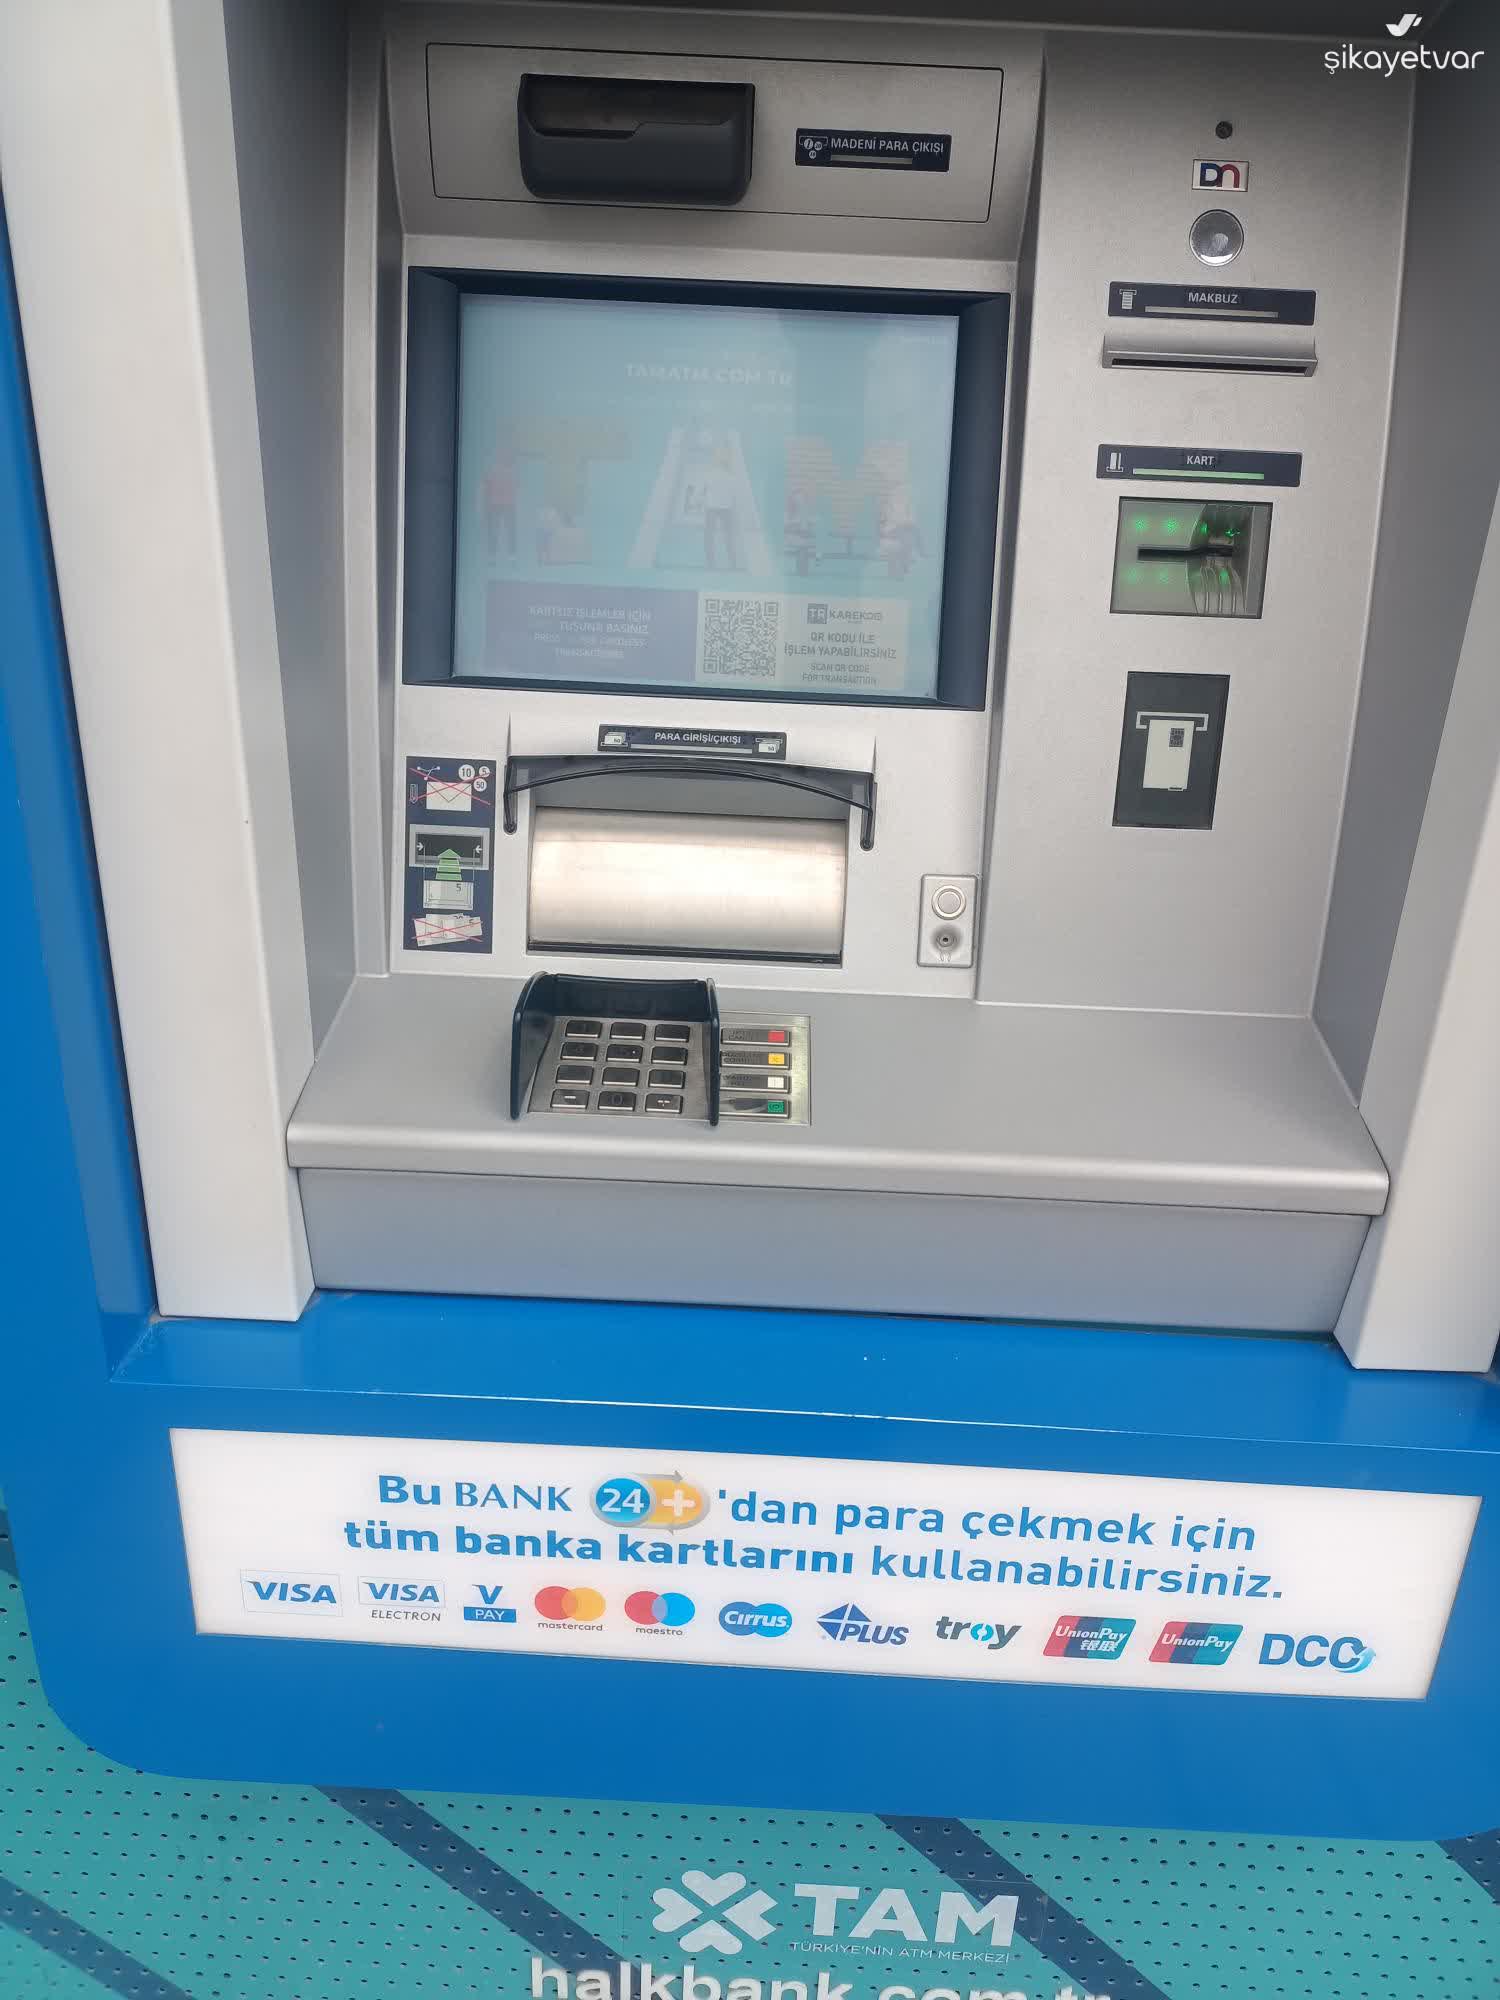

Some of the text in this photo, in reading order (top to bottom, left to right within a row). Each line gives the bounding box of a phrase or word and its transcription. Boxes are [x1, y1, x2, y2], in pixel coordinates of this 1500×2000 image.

[830, 137, 944, 155] MADENİ PARA ÇIKIŞI
[1188, 291, 1239, 304] MAKBUZ
[1186, 455, 1215, 466] KART
[810, 632, 876, 644] QR KODU İLE
[784, 642, 816, 656] İŞLEM
[810, 663, 870, 674] SCAN QR CODE
[654, 731, 680, 743] PARA
[462, 768, 471, 778] 10
[476, 781, 485, 789] 50
[378, 1475, 441, 1506] Bu
[455, 1482, 573, 1512] BANK
[718, 1489, 817, 1526] 'dan
[835, 1503, 944, 1535] para
[961, 1506, 1156, 1545] çekmek
[1171, 1515, 1255, 1552] için
[344, 1520, 1283, 1599] tüm banka kartlarını kullanabilirsiniz.
[247, 1580, 337, 1604] VISA
[362, 1581, 440, 1603] VISA
[472, 1584, 504, 1604] V
[371, 1609, 441, 1622] ELECTRON
[475, 1609, 505, 1621] PAY
[538, 1621, 603, 1632] mastercard
[635, 1626, 683, 1636] maestro
[935, 1615, 1022, 1650] troy
[840, 1624, 909, 1646] PLUS
[1055, 1625, 1128, 1643] UnionPay
[1080, 1640, 1119, 1652] 银联
[1161, 1633, 1234, 1652] UnionPay
[1259, 1633, 1367, 1669] DCC
[794, 1883, 1019, 1947] TAM
[899, 1948, 933, 1959] ATM
